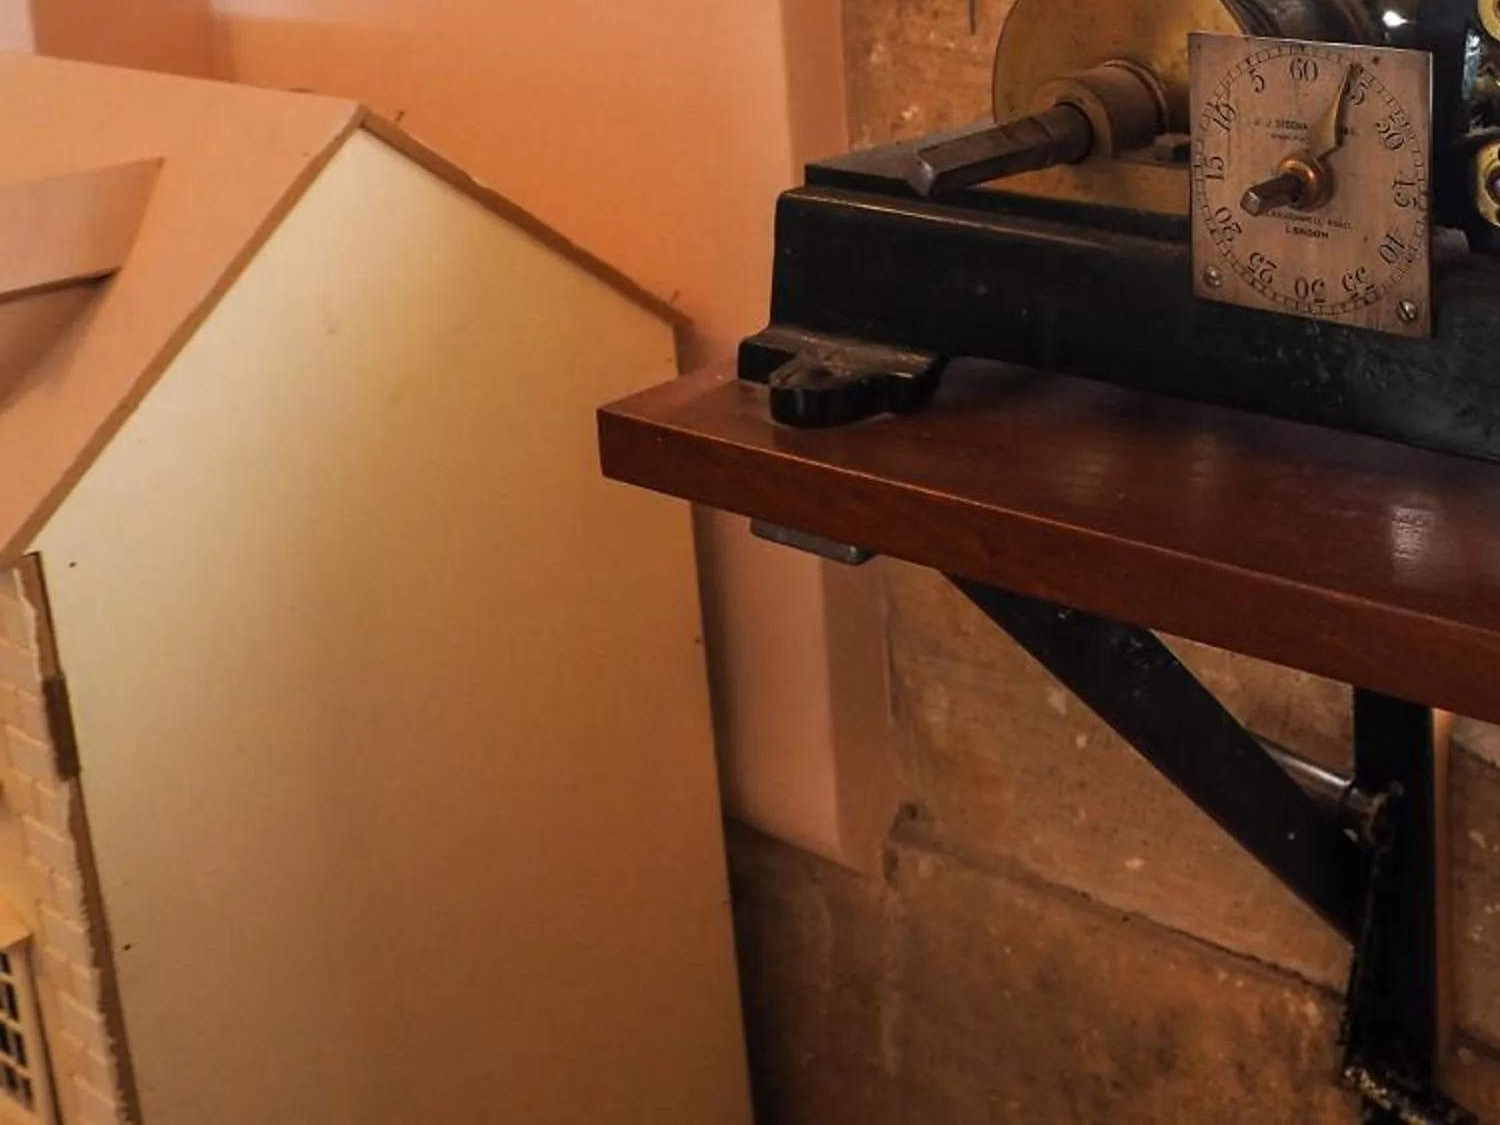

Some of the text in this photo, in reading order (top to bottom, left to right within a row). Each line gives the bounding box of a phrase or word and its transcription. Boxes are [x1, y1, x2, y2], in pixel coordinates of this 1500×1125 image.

[1248, 67, 1266, 93] 5
[1290, 58, 1319, 81] 60
[1376, 114, 1406, 151] 50
[1205, 155, 1225, 181] 15
[1214, 206, 1243, 243] 20
[1249, 251, 1277, 285] 25
